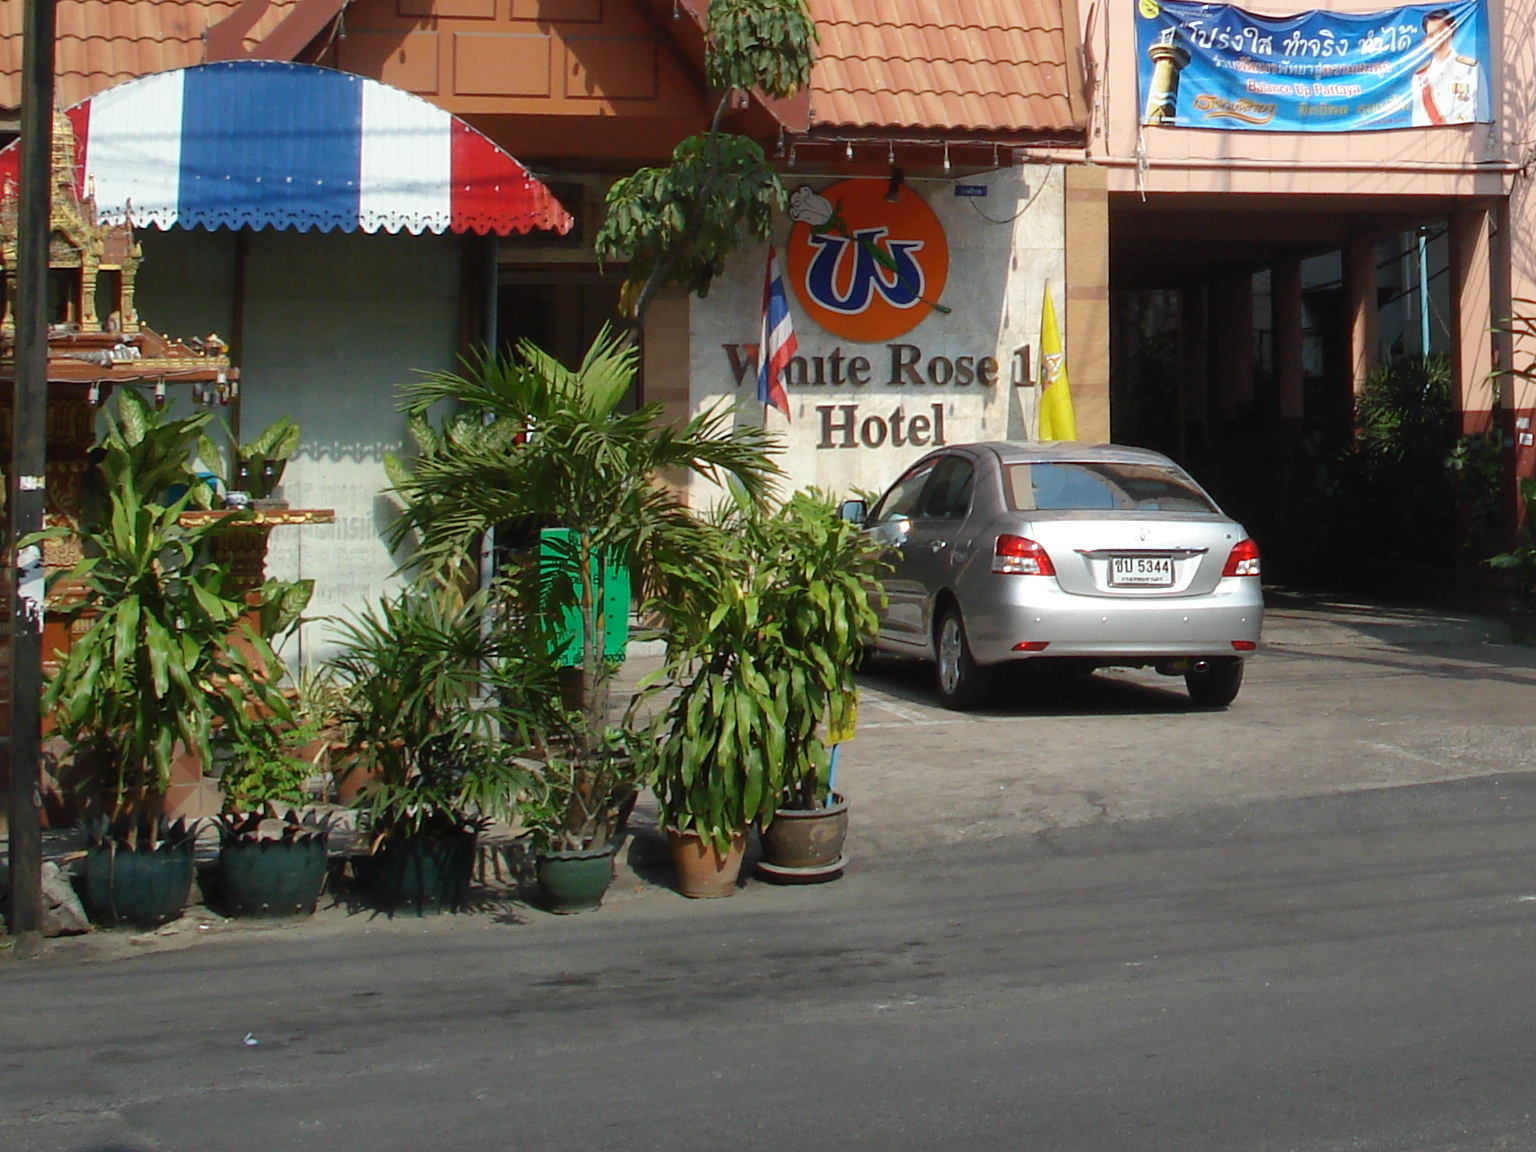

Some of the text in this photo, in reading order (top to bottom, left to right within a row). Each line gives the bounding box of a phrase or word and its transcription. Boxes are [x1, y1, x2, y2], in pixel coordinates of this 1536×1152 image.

[1247, 79, 1362, 98] Balance Up Pattaya
[887, 343, 999, 386] Rose
[1013, 344, 1036, 387] 1
[816, 403, 946, 449] Hotel
[1138, 559, 1169, 574] 5344
